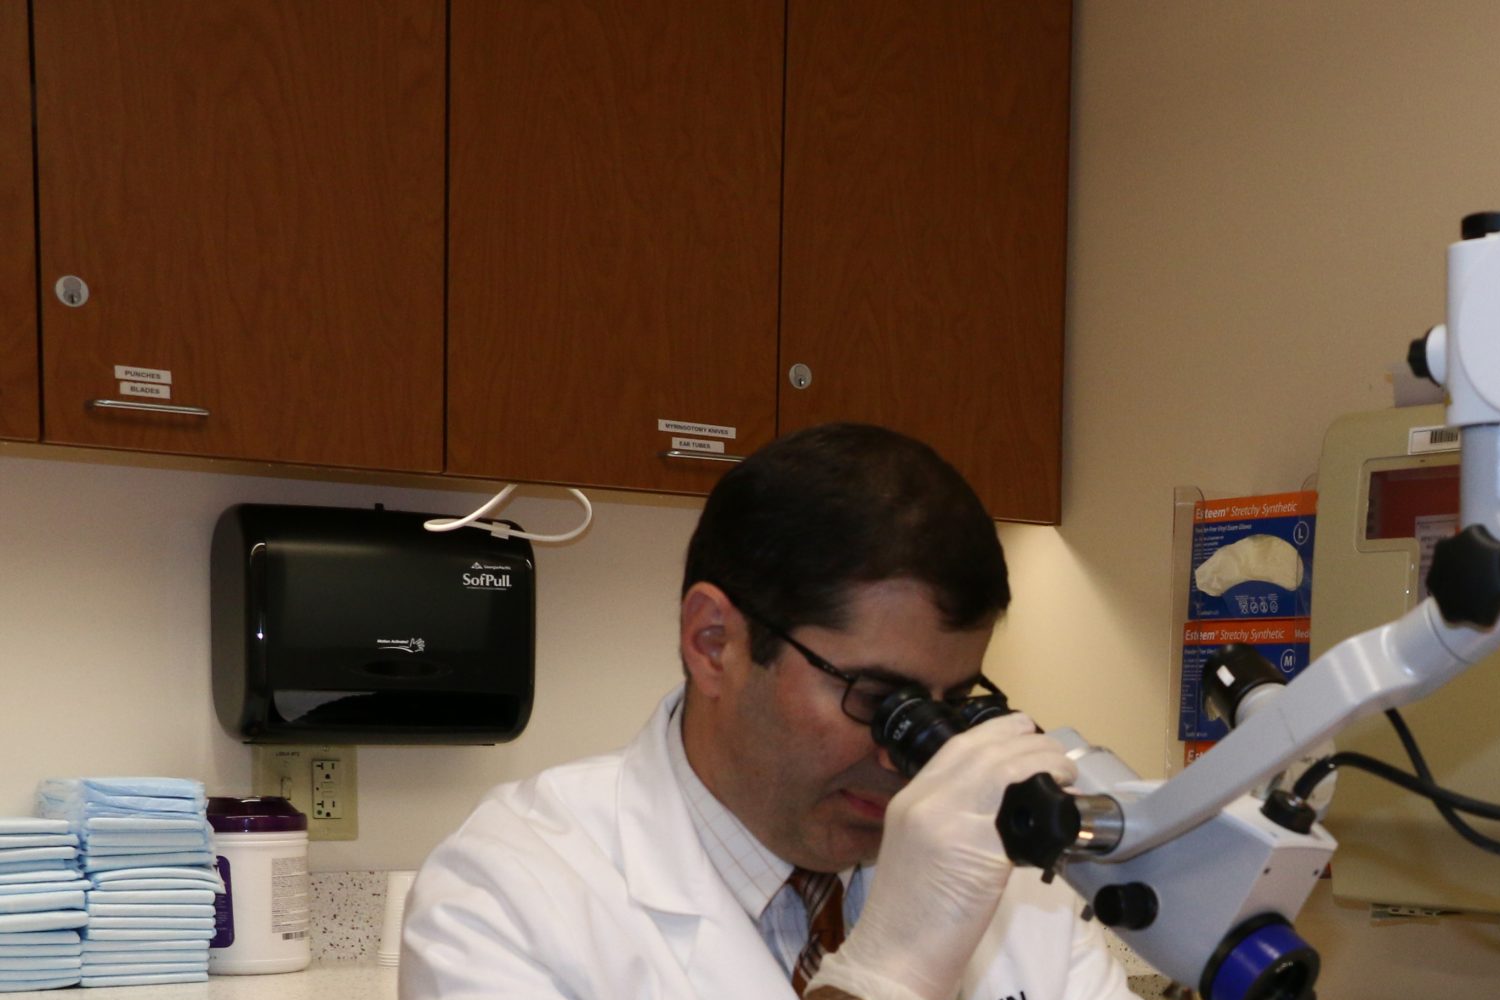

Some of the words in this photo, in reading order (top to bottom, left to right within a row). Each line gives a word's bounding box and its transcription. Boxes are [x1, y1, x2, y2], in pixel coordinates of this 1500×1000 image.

[124, 370, 161, 379] PUNCHES
[130, 385, 160, 395] BLADES
[1231, 504, 1261, 517] Stretchy
[1262, 502, 1298, 515] Synthetic
[1297, 527, 1304, 539] L
[462, 572, 512, 587] SofPull
[1220, 629, 1249, 642] Stretchy
[1250, 628, 1285, 641] Synthetic
[1283, 655, 1294, 667] M
